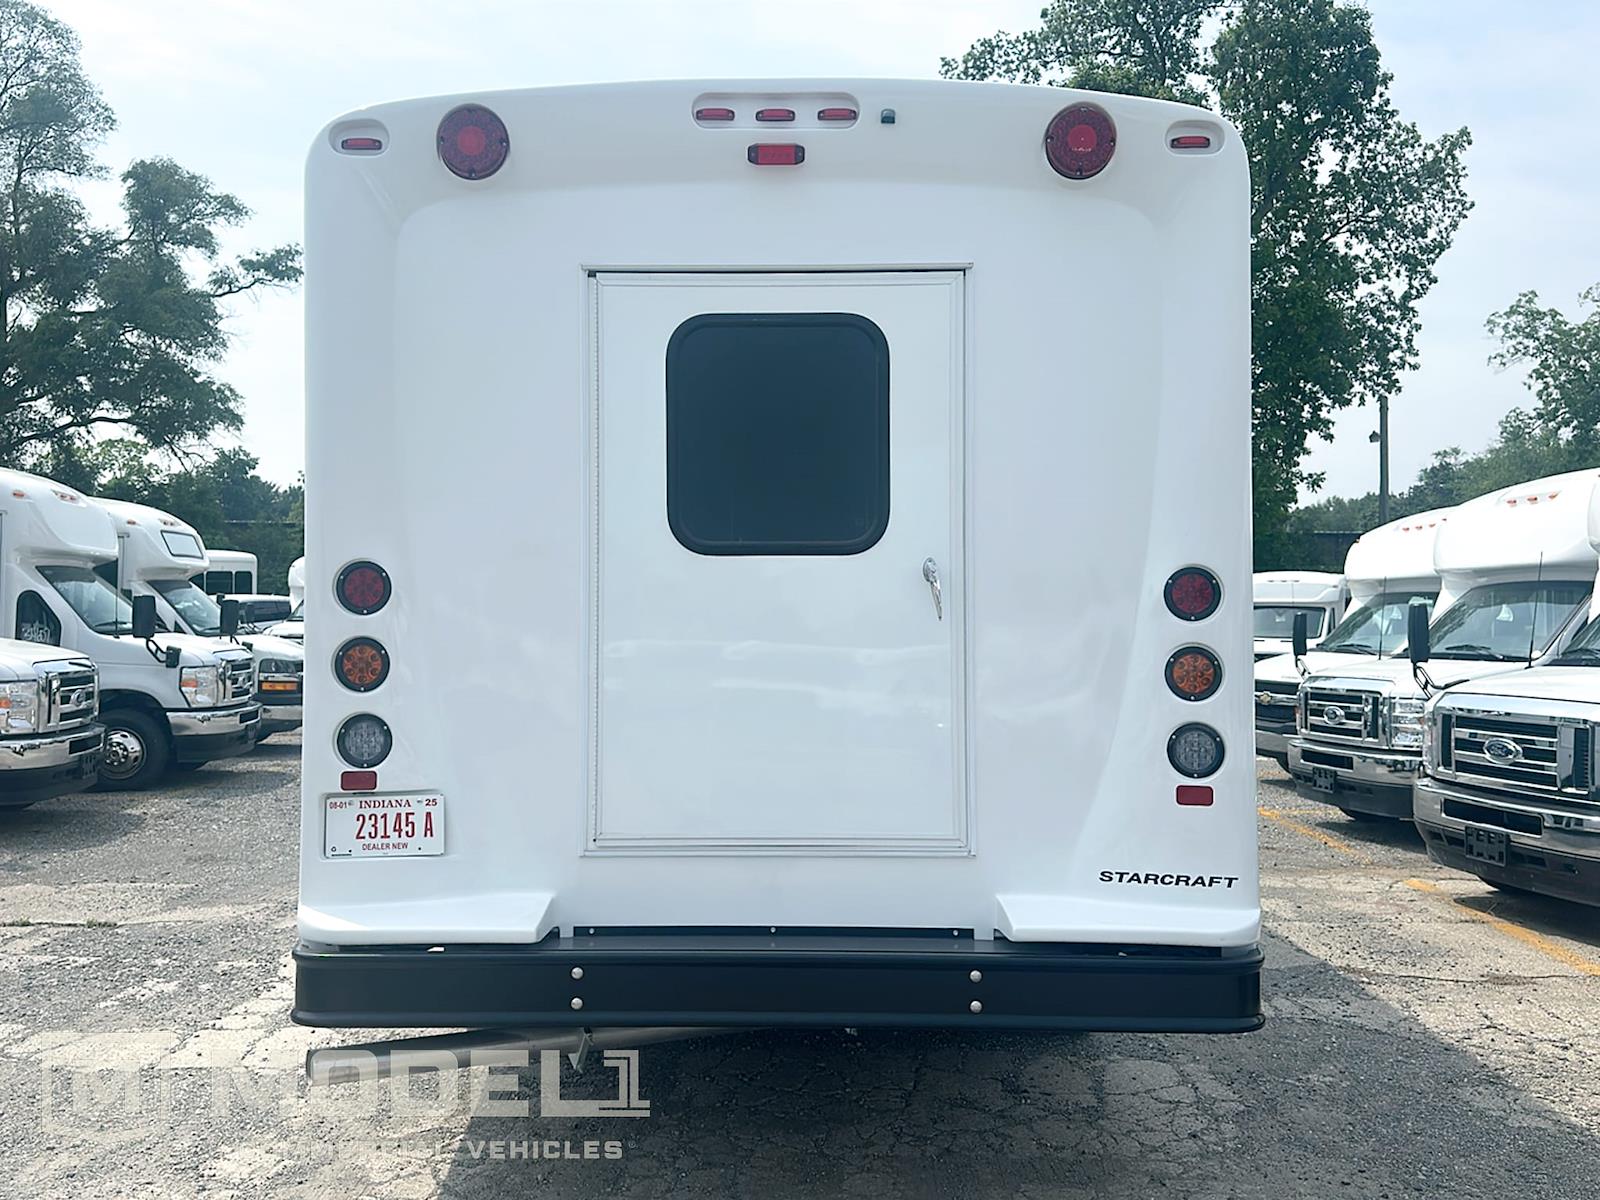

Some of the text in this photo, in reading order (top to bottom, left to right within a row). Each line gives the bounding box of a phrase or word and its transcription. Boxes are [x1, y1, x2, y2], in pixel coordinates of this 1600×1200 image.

[359, 799, 412, 809] INDIANA
[425, 798, 438, 807] 25
[355, 811, 434, 839] 23145 A
[362, 842, 409, 851] DEALER NEW
[1099, 871, 1239, 888] STARCRAFT
